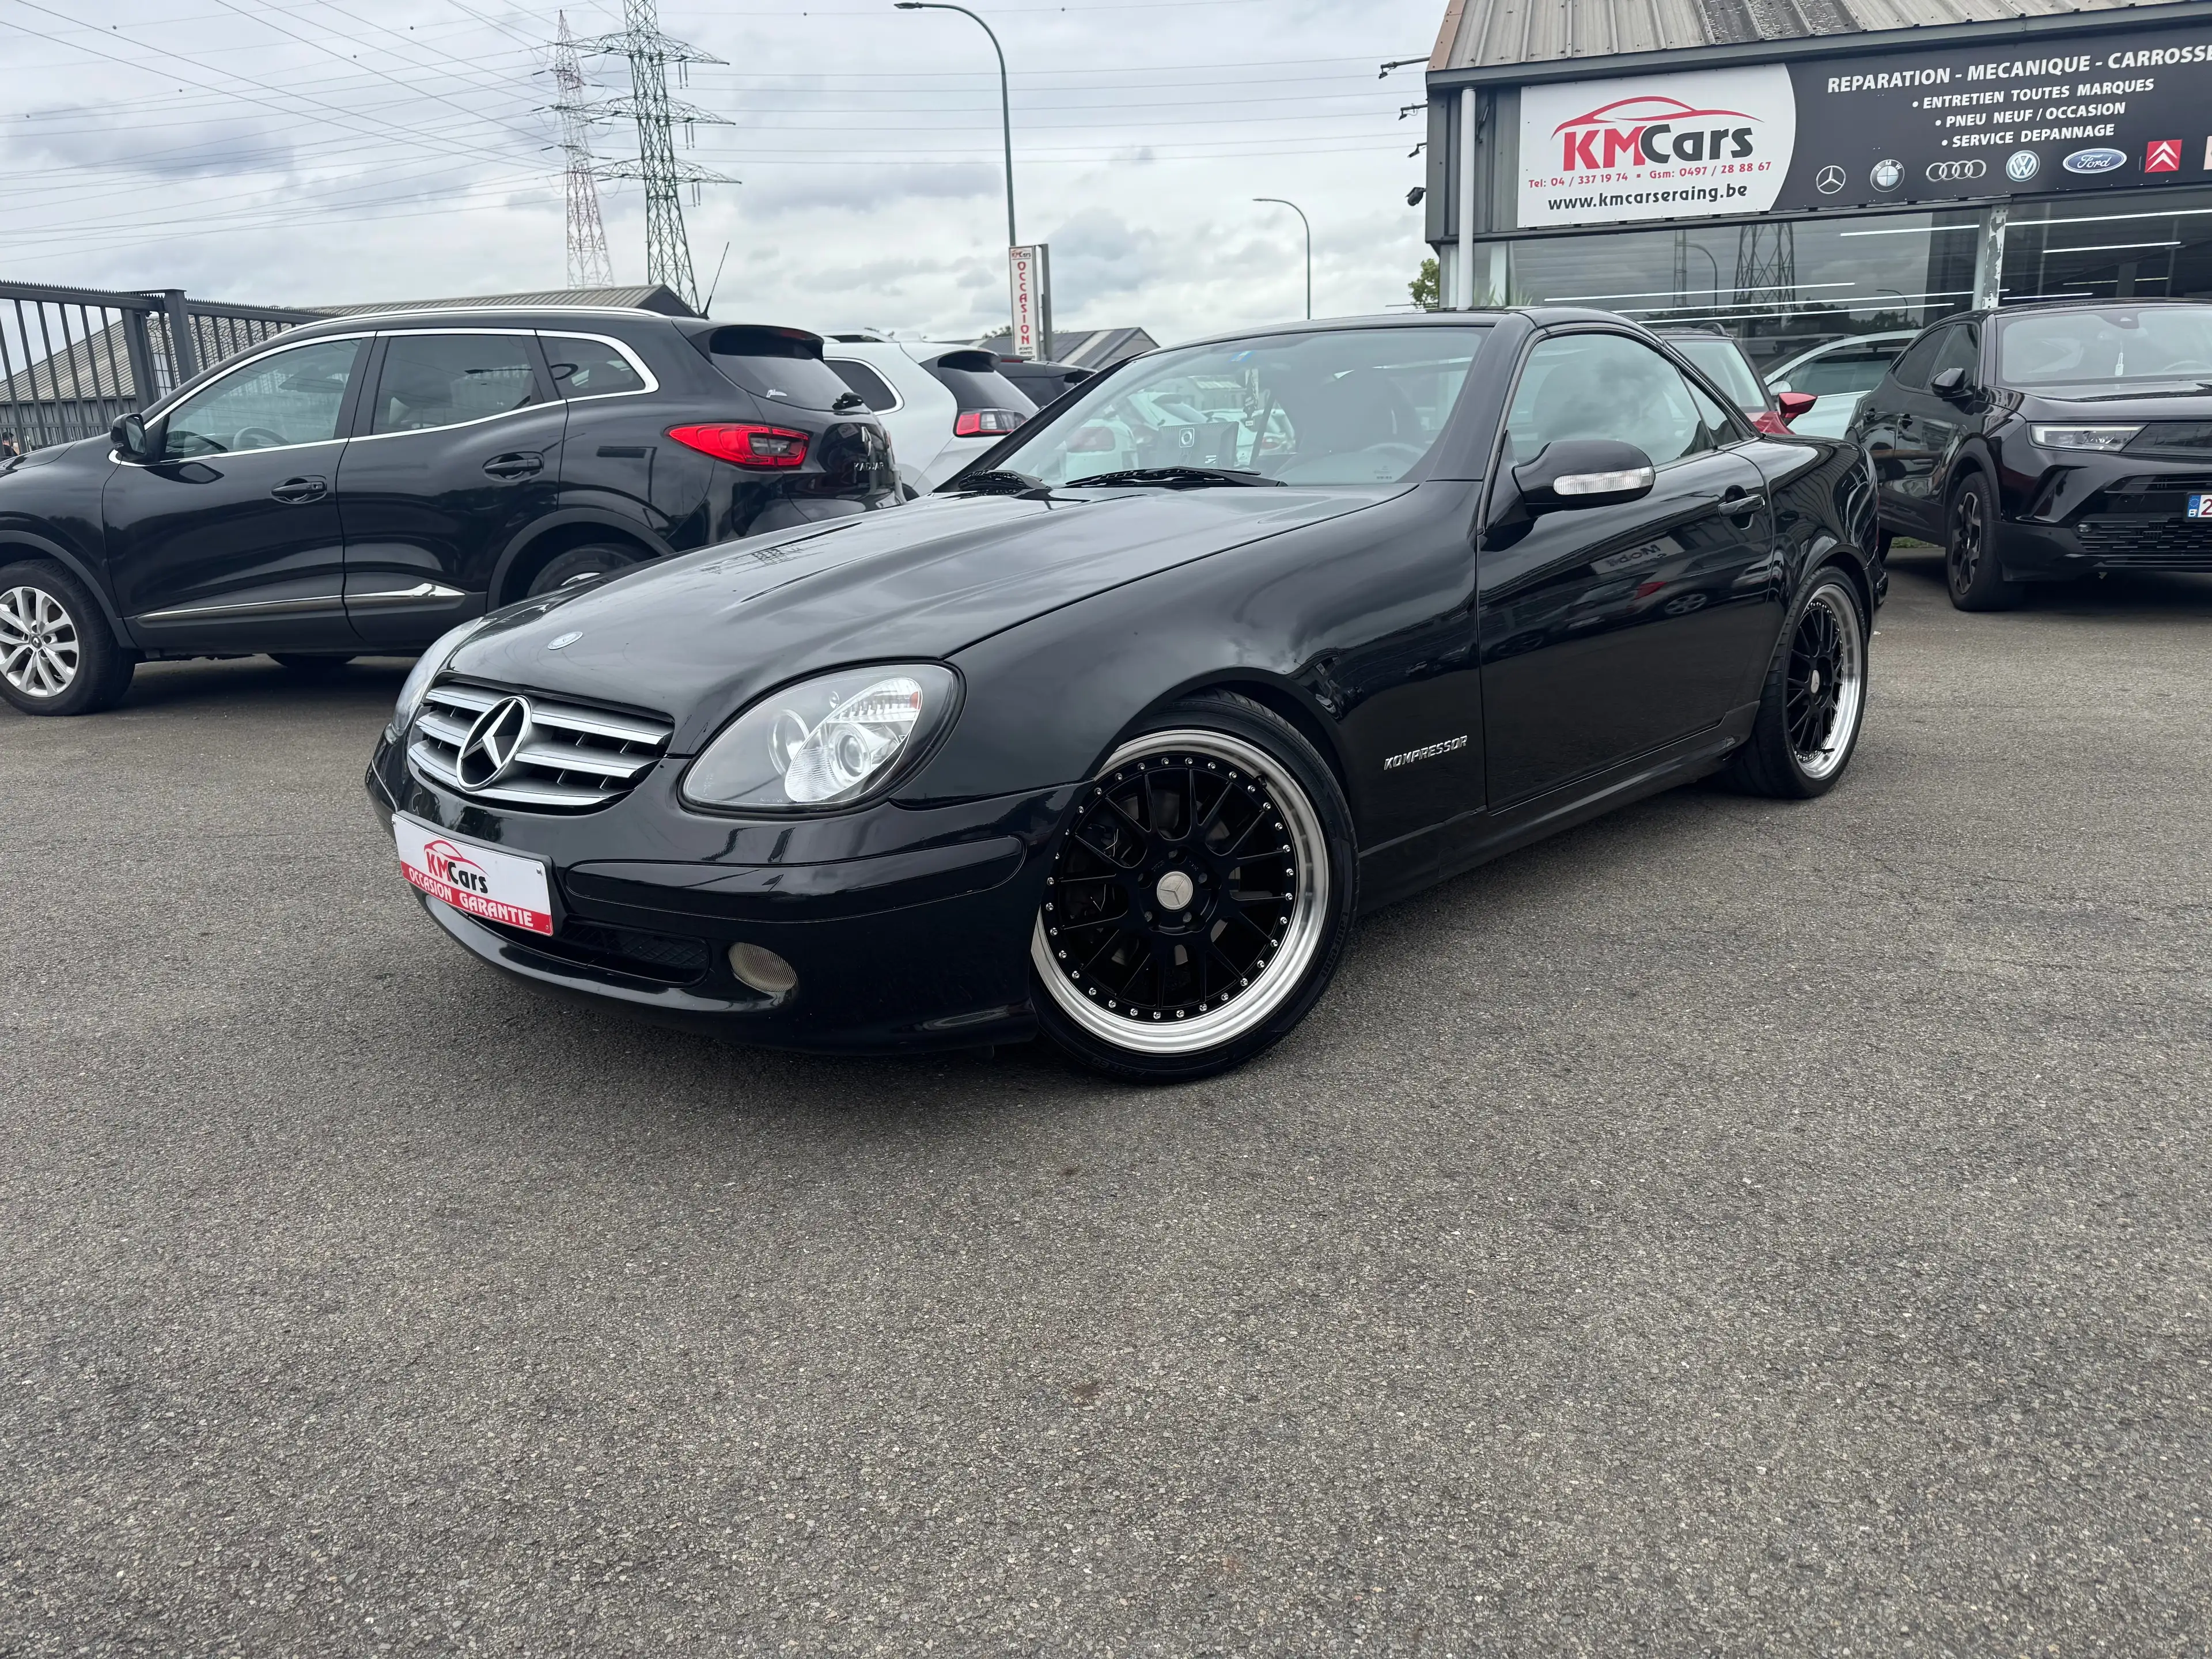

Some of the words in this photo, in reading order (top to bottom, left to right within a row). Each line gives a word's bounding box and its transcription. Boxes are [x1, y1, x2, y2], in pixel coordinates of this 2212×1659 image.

[1828, 68, 1950, 93] REPARATION
[1968, 56, 2090, 81] MECANIQUE
[1923, 91, 2004, 108] ENTRETIEN
[2012, 86, 2069, 101] TOUTES
[2077, 79, 2154, 96] MARQUES
[1946, 113, 1986, 127] PNEU
[1994, 109, 2033, 123] NEUF
[2046, 102, 2125, 119] OCCASION
[1563, 123, 1753, 171] KMCars
[1953, 132, 2013, 147] SERVICE
[2021, 124, 2114, 142] DEPANNAGE
[1529, 179, 1546, 188] Tel:
[1551, 177, 1564, 186] 04
[1569, 177, 1574, 187] /
[1578, 175, 1596, 184] 337
[1601, 174, 1611, 183] 19
[1616, 173, 1628, 181] 74
[1650, 171, 1674, 179] Gsm:
[1680, 166, 1707, 176] 0497
[1711, 166, 1717, 176] /
[1721, 165, 1734, 173] 28
[1740, 163, 1752, 172] 88
[1758, 162, 1771, 171] 67
[2077, 154, 2112, 168] Ford
[1548, 183, 1747, 210] www.kmcarseraing.be
[1017, 262, 1030, 344] OCCASION
[2188, 509, 2197, 517] B
[1384, 735, 1468, 770] KOMPRESSOR
[426, 851, 488, 893] KMCars
[408, 868, 453, 902] OCCASION
[459, 893, 533, 927] GARANTIE
